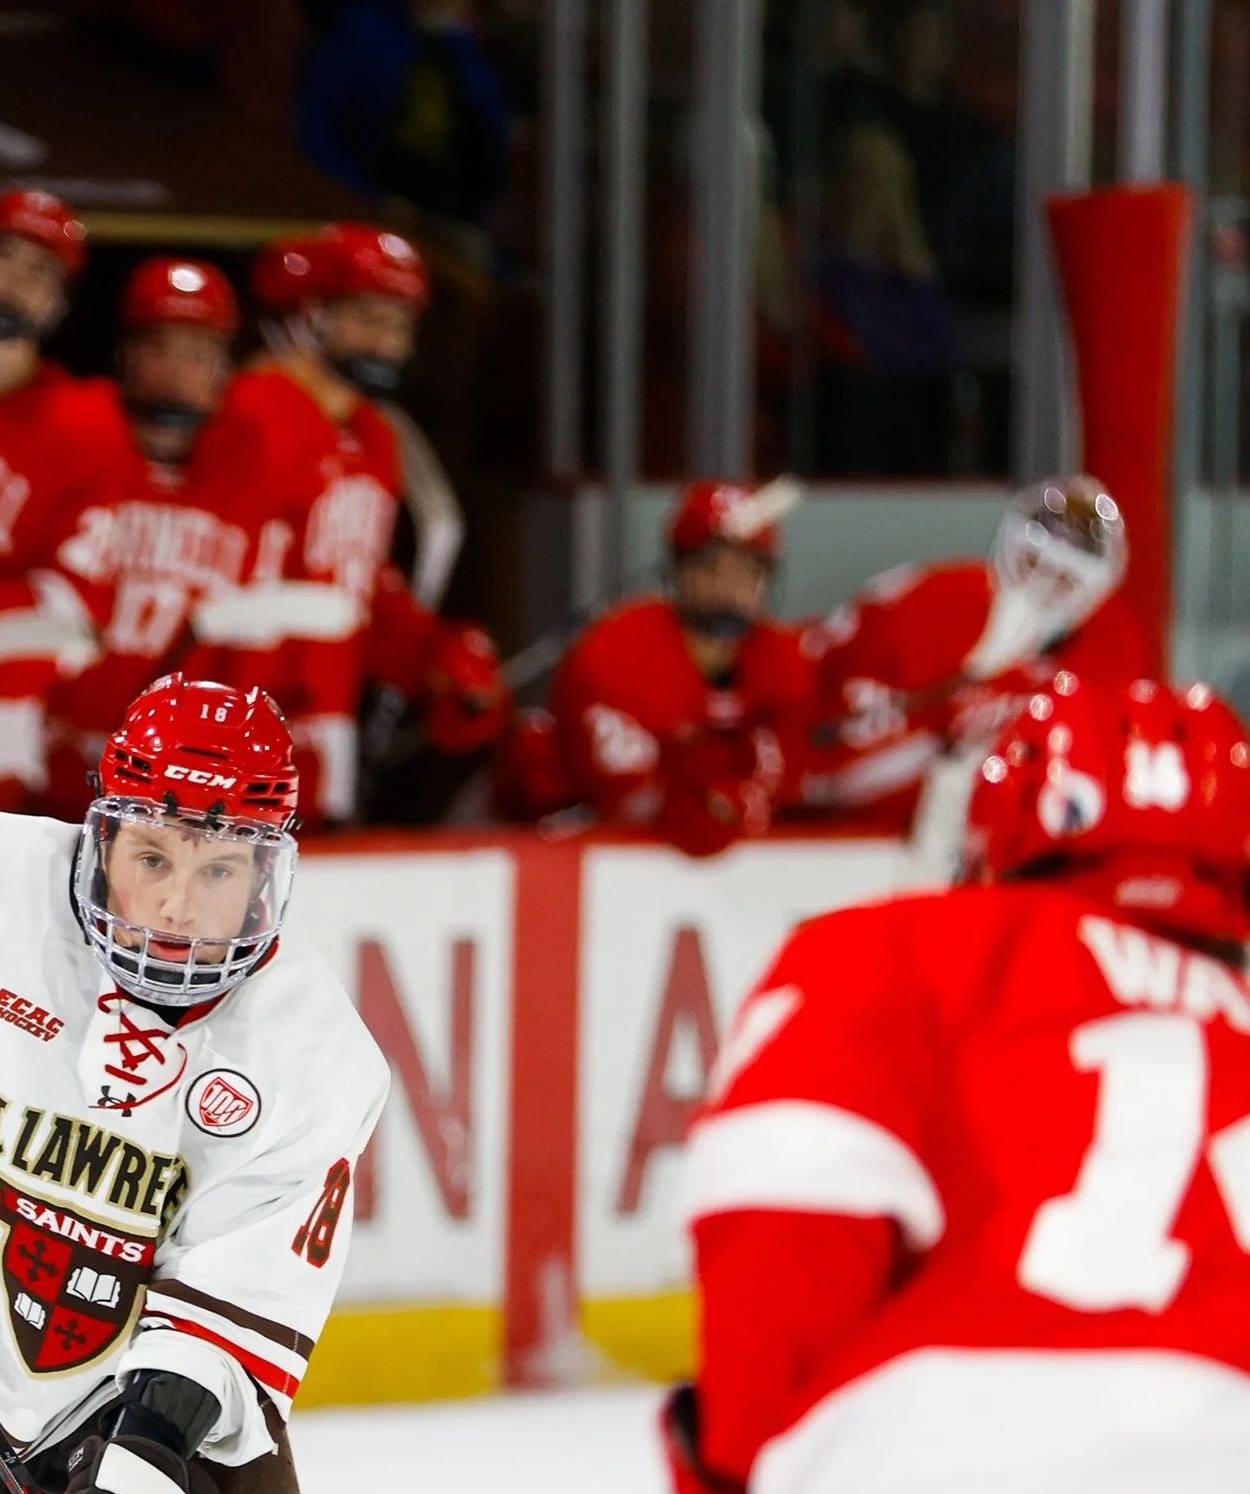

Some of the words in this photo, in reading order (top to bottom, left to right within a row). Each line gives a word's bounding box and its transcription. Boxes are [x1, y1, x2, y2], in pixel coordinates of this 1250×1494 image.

[200, 704, 228, 723] 18
[164, 765, 237, 790] CCM
[16, 1197, 147, 1263] SAINTS
[291, 1157, 351, 1269] 18
